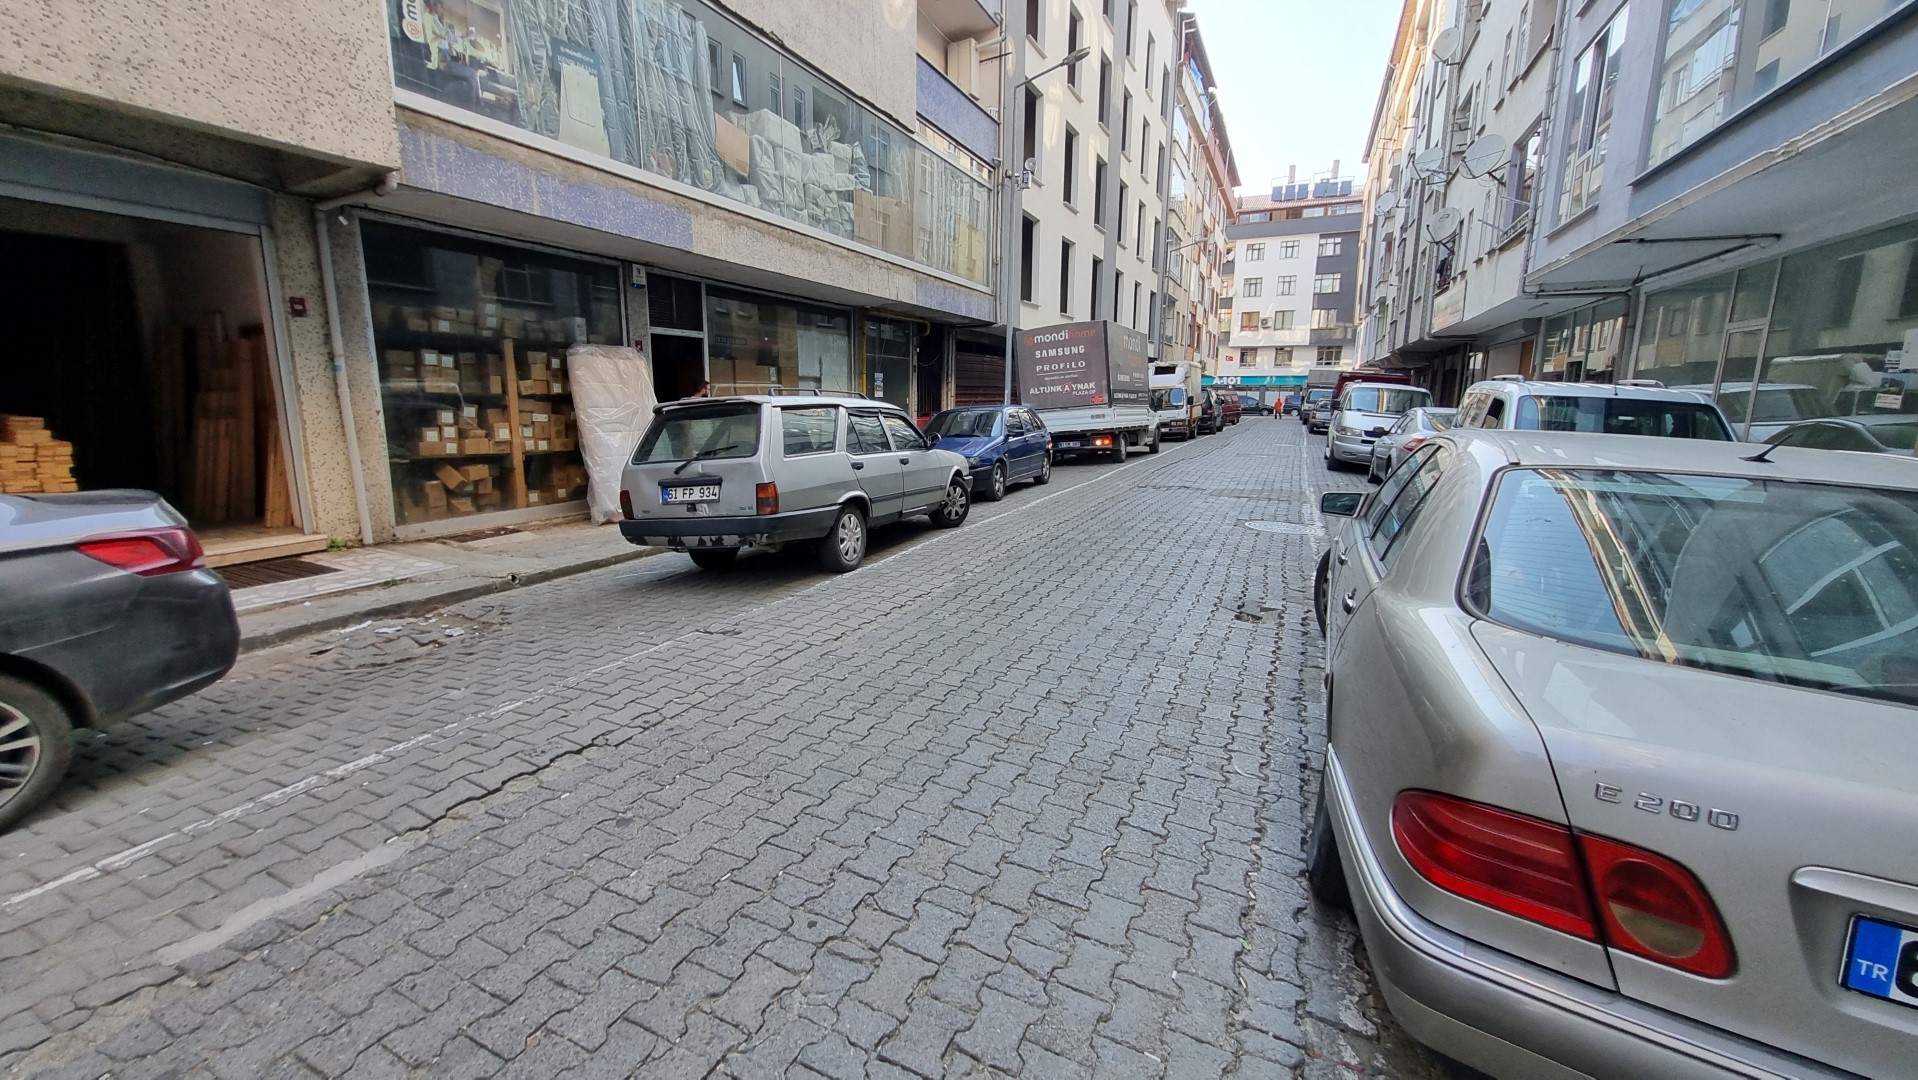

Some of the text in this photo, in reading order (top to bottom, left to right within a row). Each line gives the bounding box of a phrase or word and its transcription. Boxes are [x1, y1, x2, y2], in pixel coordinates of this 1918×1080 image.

[1035, 345, 1085, 359] SAMSUNG
[1029, 381, 1096, 395] ALTUNKAYNAK
[668, 486, 717, 500] 61 FP 934
[1594, 782, 1740, 832] E 200
[1856, 958, 1889, 982] TR
